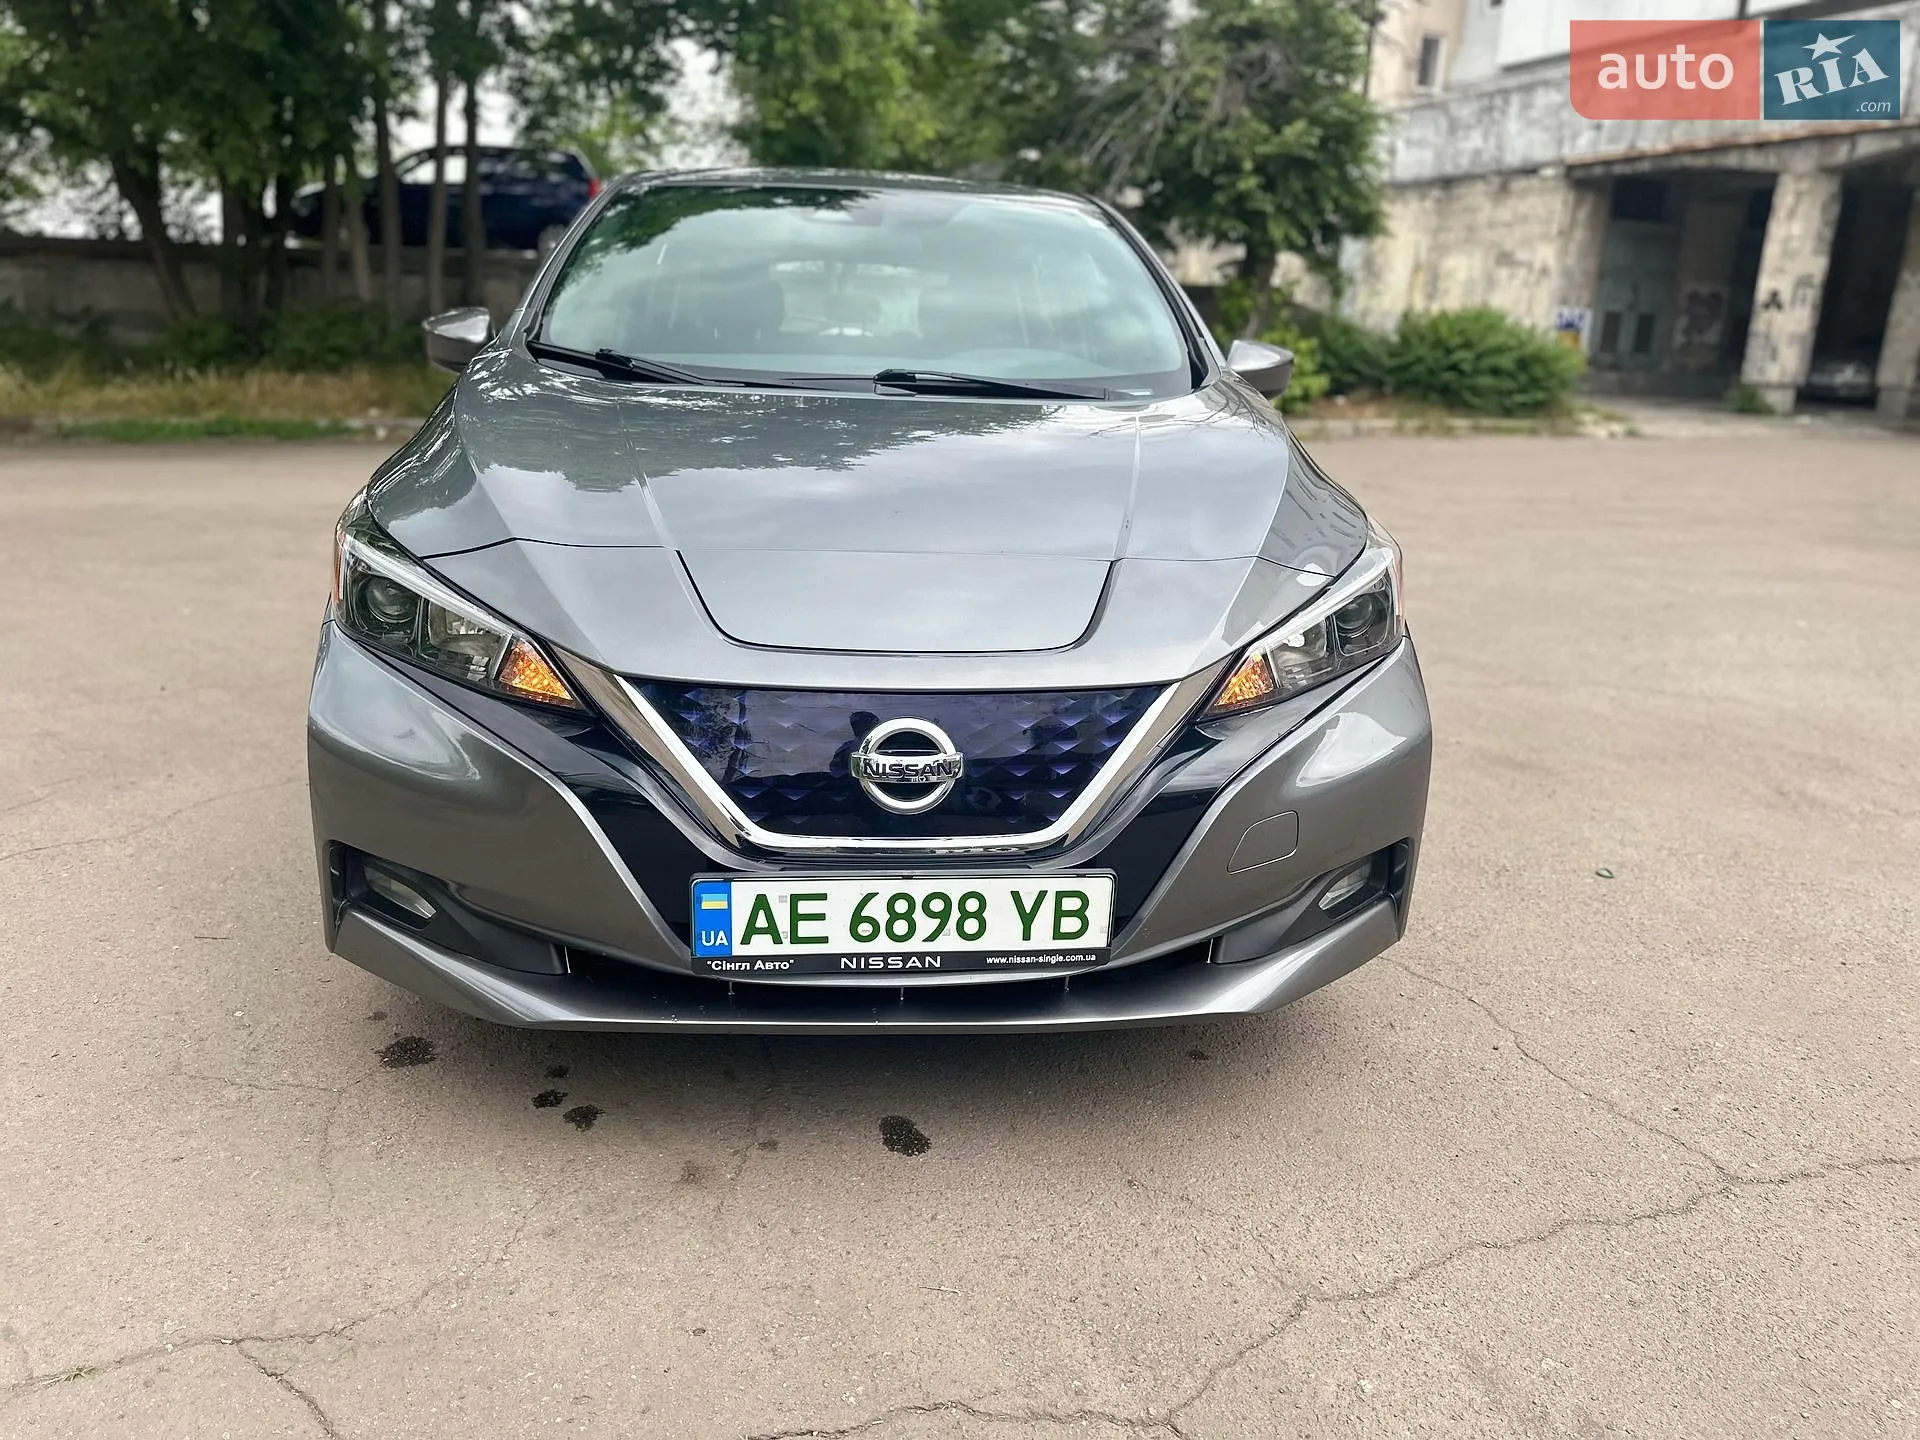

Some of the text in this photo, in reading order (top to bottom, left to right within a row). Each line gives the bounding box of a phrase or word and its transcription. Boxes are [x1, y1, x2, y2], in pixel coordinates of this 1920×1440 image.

[863, 760, 954, 778] NISSAN
[739, 889, 1091, 946] AE 6898 YB
[701, 930, 729, 947] UA
[753, 958, 795, 971] Авто"
[840, 955, 942, 970] NISSAN
[986, 953, 1097, 965] www.nissan-single.com.ua
